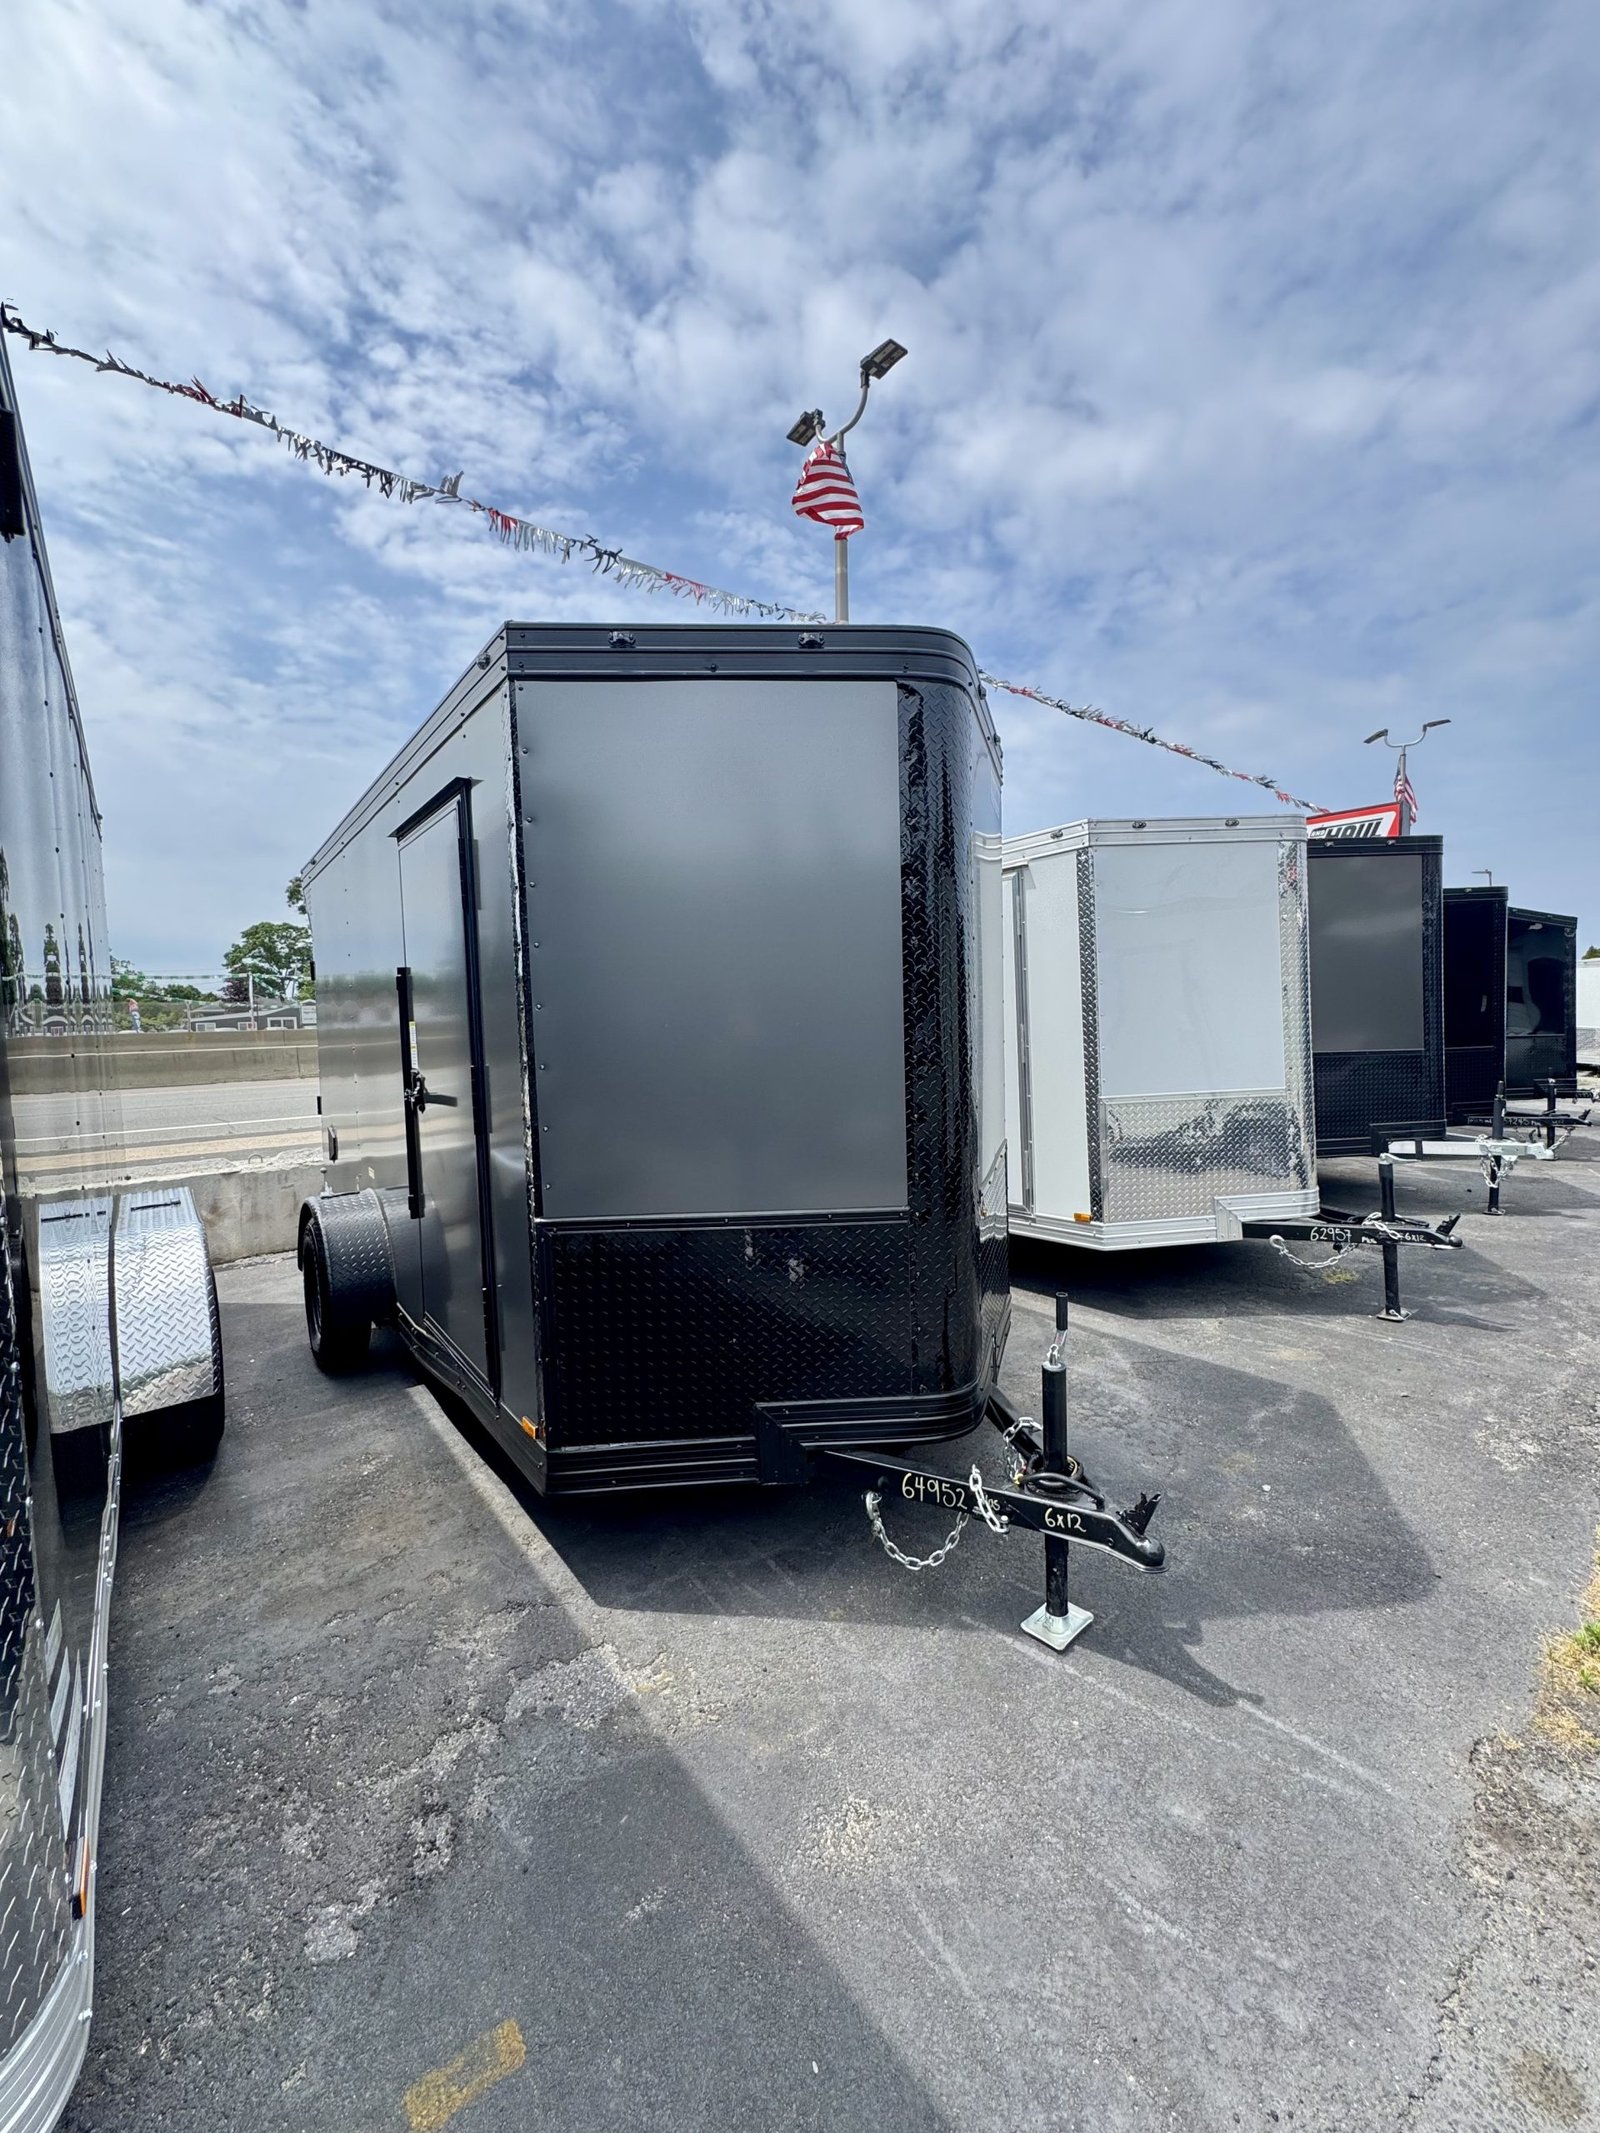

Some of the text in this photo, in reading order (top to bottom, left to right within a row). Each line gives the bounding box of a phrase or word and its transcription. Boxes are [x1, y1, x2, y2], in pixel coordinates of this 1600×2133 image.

[1310, 1226, 1352, 1243] 62957
[901, 1472, 968, 1510] 64952
[1044, 1507, 1087, 1533] 6x12
